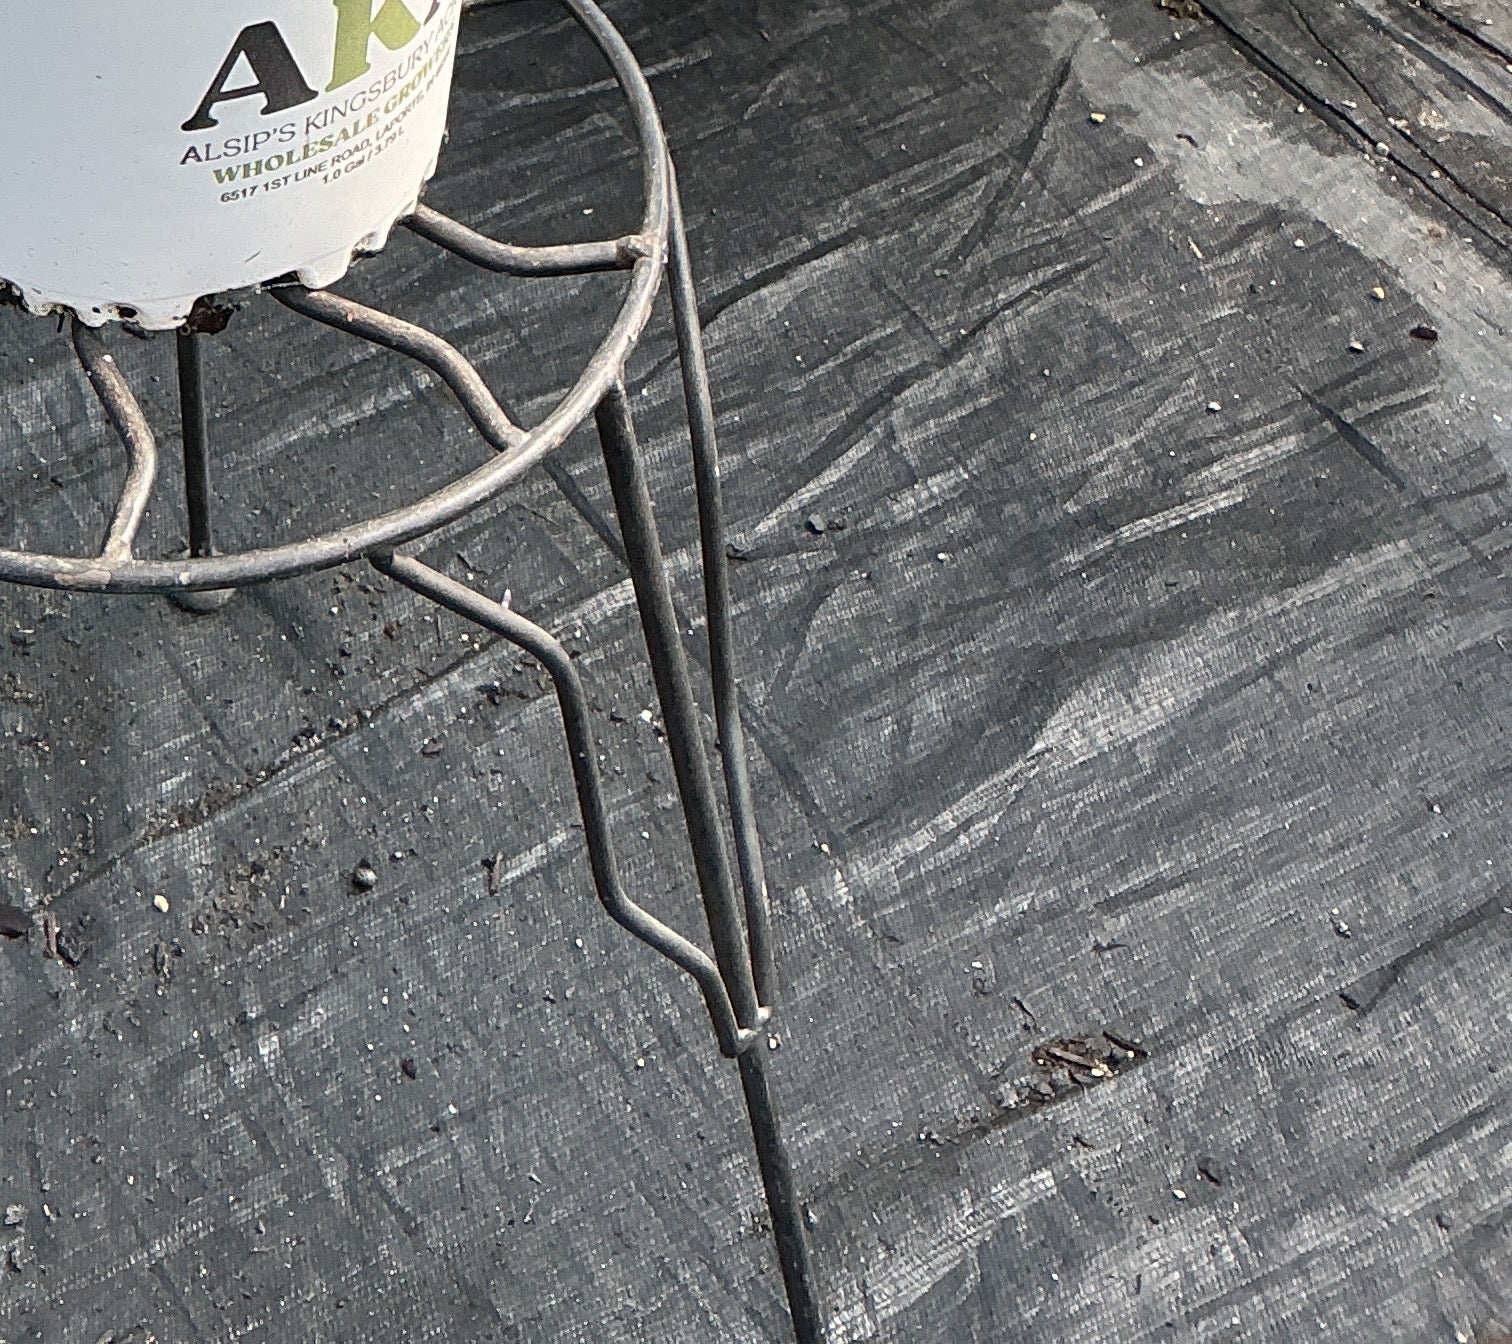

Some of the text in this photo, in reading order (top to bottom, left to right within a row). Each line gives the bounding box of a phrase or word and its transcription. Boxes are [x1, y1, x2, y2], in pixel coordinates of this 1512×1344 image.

[180, 123, 297, 165] ALSIP'S
[304, 29, 434, 136] KINGSBURY
[212, 107, 381, 185] WHOLESALE
[322, 167, 341, 185] 1.0
[345, 155, 365, 174] Gal
[220, 182, 259, 204] 6517
[263, 173, 292, 193] 1ST
[294, 158, 328, 182] LINE
